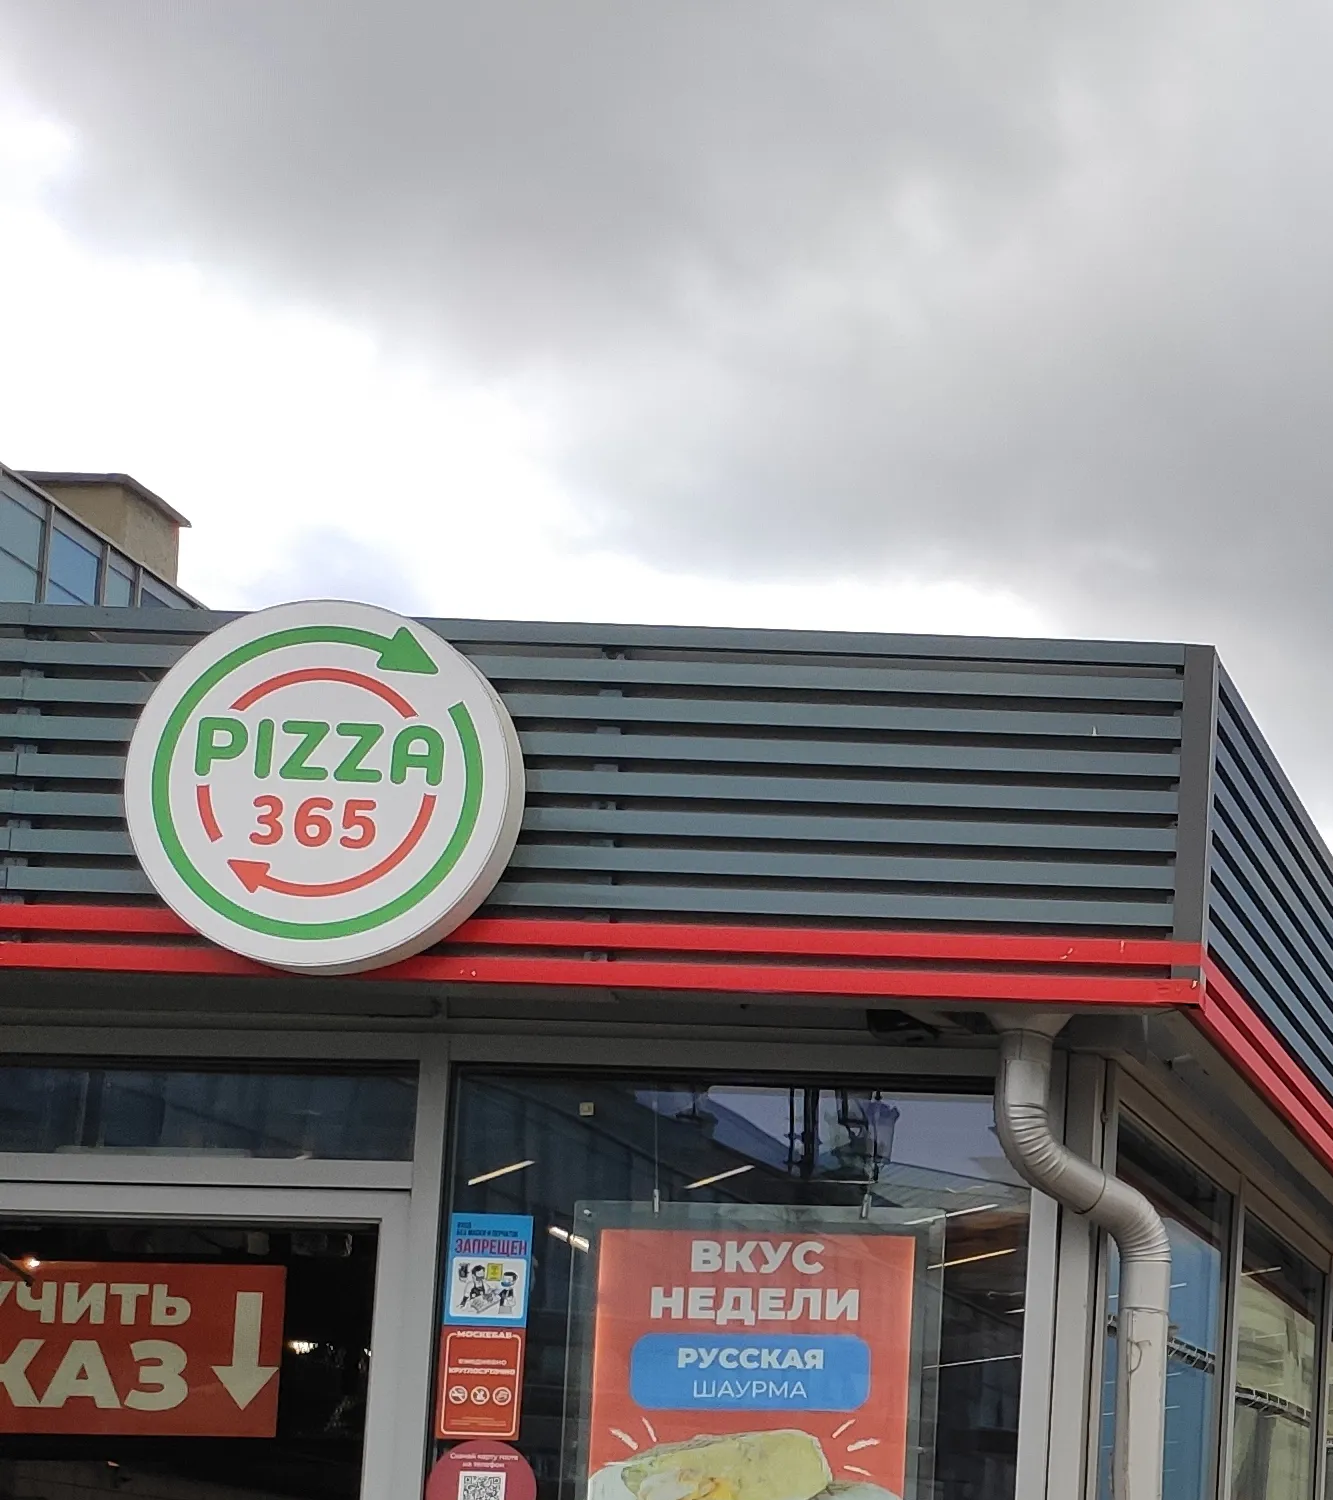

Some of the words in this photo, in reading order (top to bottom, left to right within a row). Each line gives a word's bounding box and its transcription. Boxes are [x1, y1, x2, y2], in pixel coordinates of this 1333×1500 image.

[194, 716, 444, 786] PIZZA
[248, 795, 377, 849] 365
[455, 1239, 527, 1256] ЗАПРЕЩЕН
[690, 1240, 826, 1274] ВКУС
[650, 1287, 860, 1326] НЕДЕЛИ
[677, 1348, 825, 1371] РУССКАЯ
[692, 1379, 808, 1400] ШАУРМА
